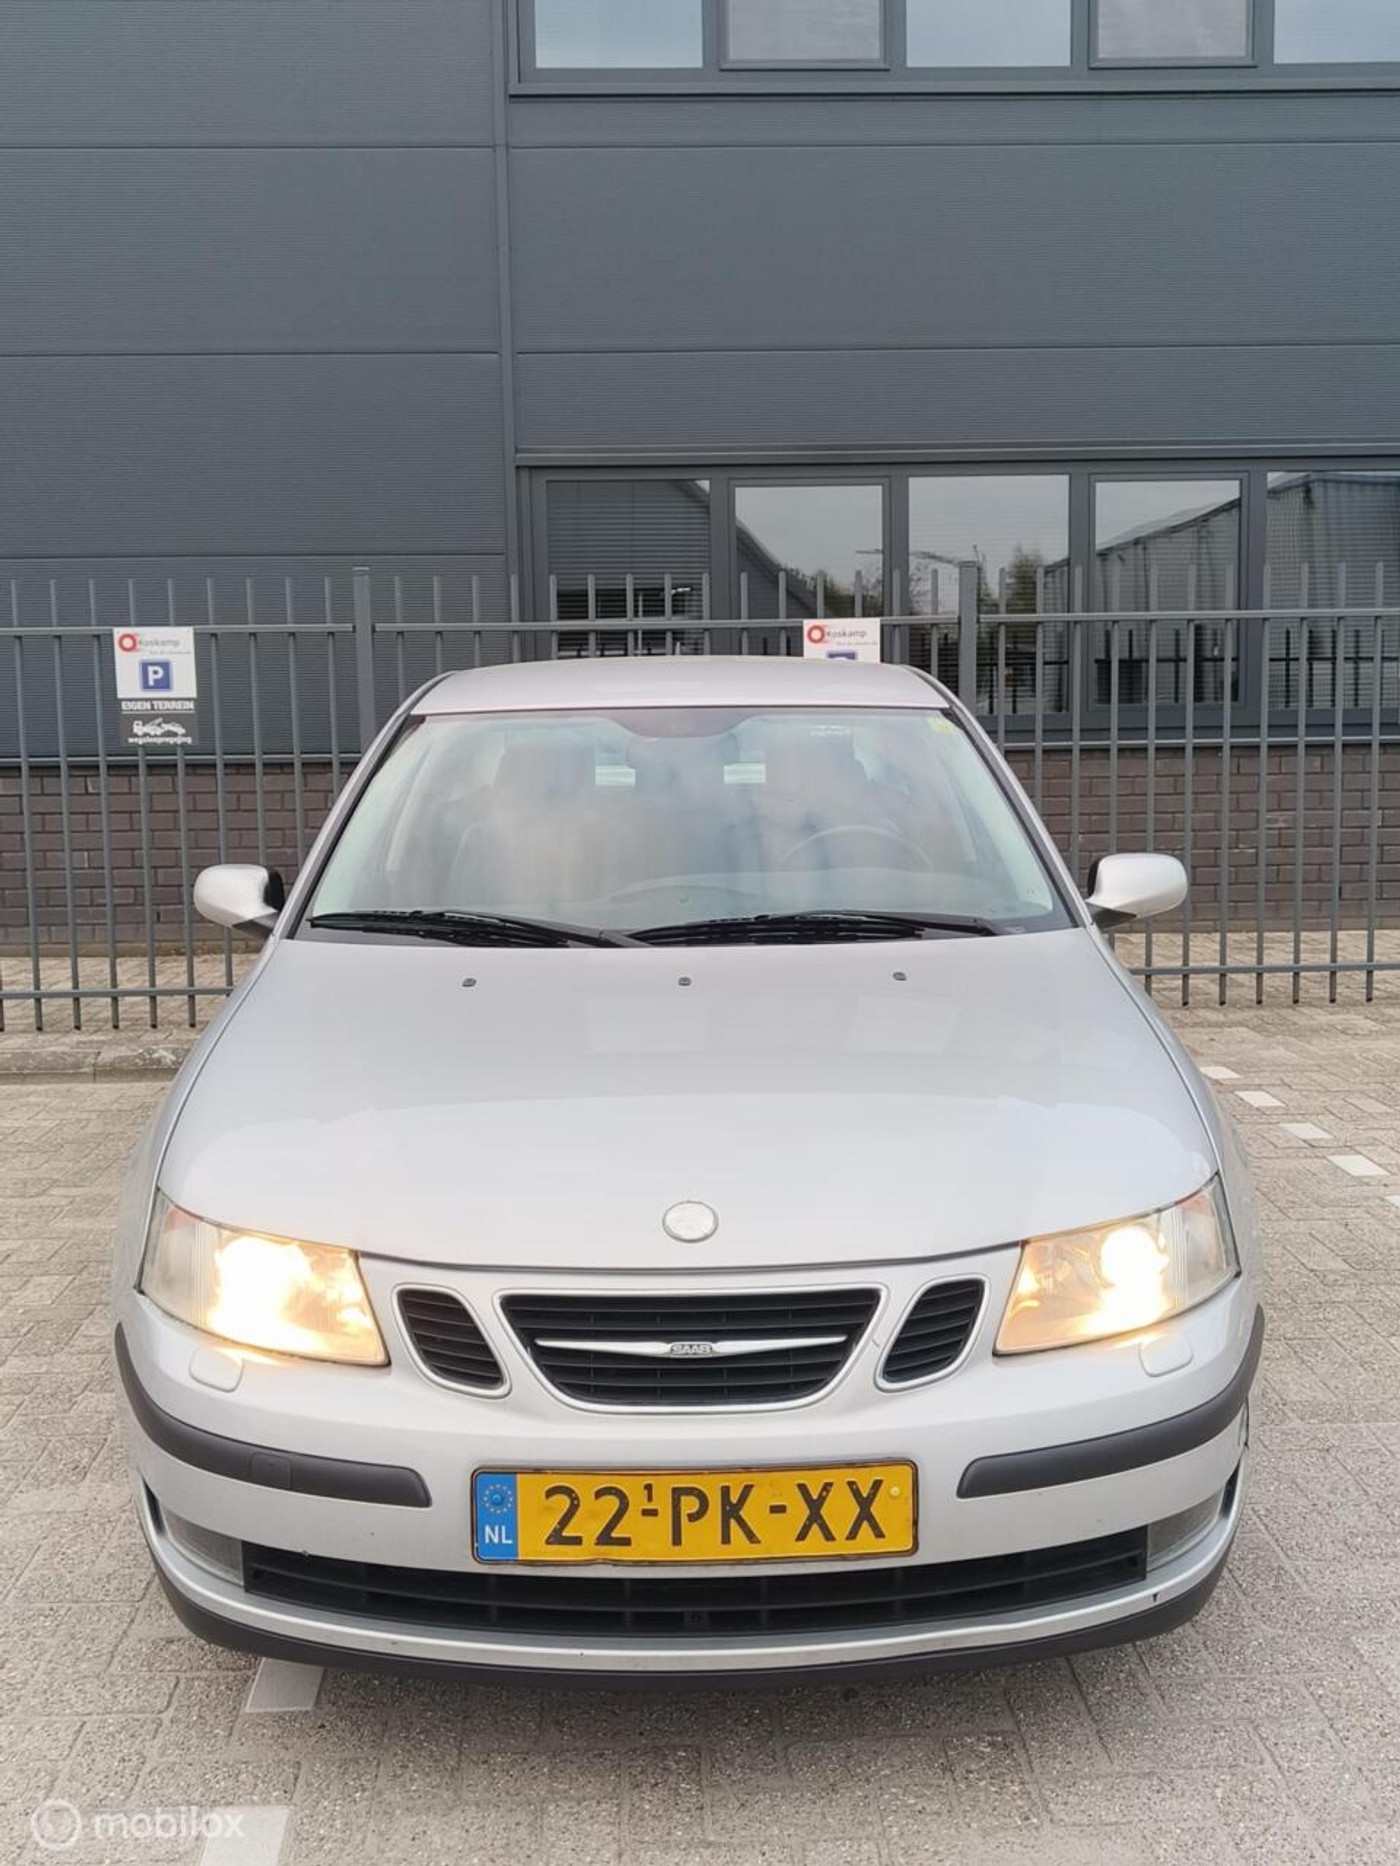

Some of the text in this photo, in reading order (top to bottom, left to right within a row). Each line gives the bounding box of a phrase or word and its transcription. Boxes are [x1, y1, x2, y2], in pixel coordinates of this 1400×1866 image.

[826, 630, 867, 639] Koskamp
[139, 638, 181, 648] Koskamp
[147, 666, 164, 686] P
[121, 700, 195, 710] EIGEN TERREIN
[484, 1524, 513, 1545] NL
